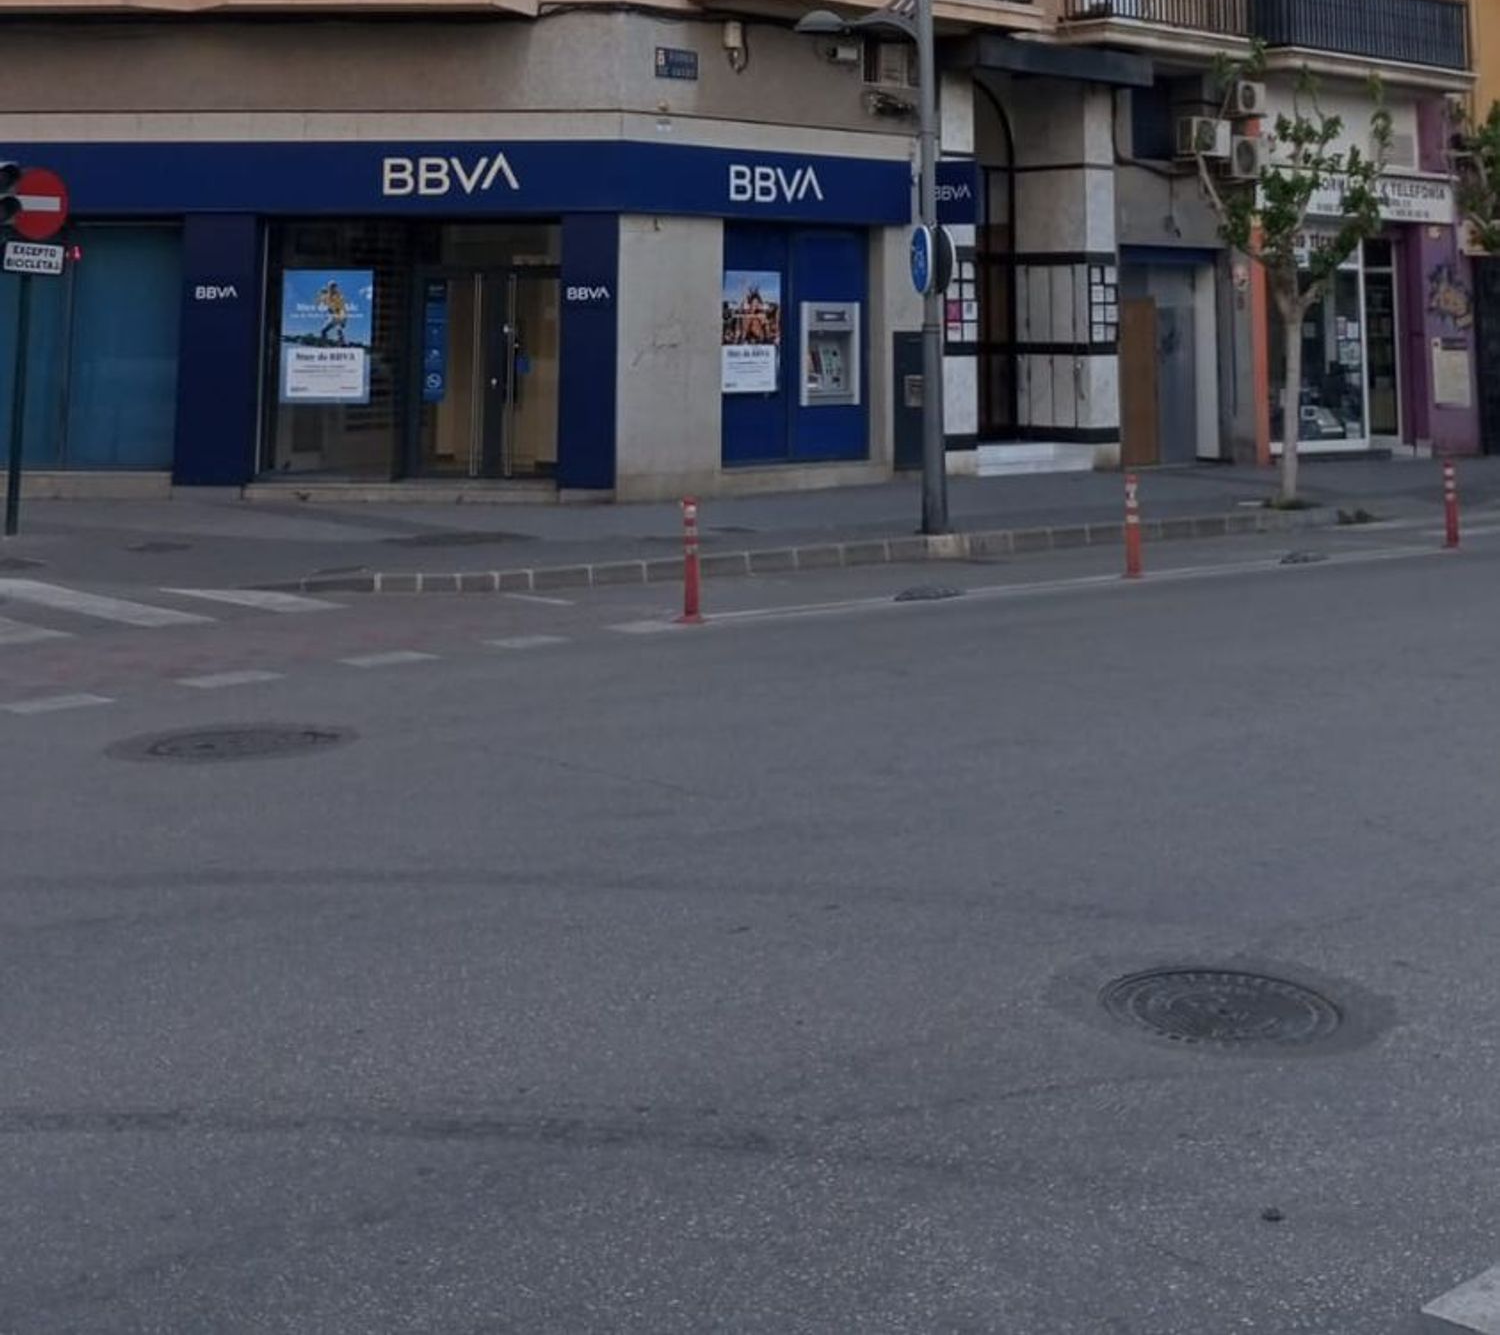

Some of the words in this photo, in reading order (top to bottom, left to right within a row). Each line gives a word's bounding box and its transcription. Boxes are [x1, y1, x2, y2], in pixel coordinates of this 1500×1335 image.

[382, 152, 519, 196] BBVA
[729, 165, 824, 203] BBVA
[13, 245, 57, 258] EXCEPTO
[195, 286, 238, 300] BBVA
[566, 286, 610, 300] BBVA
